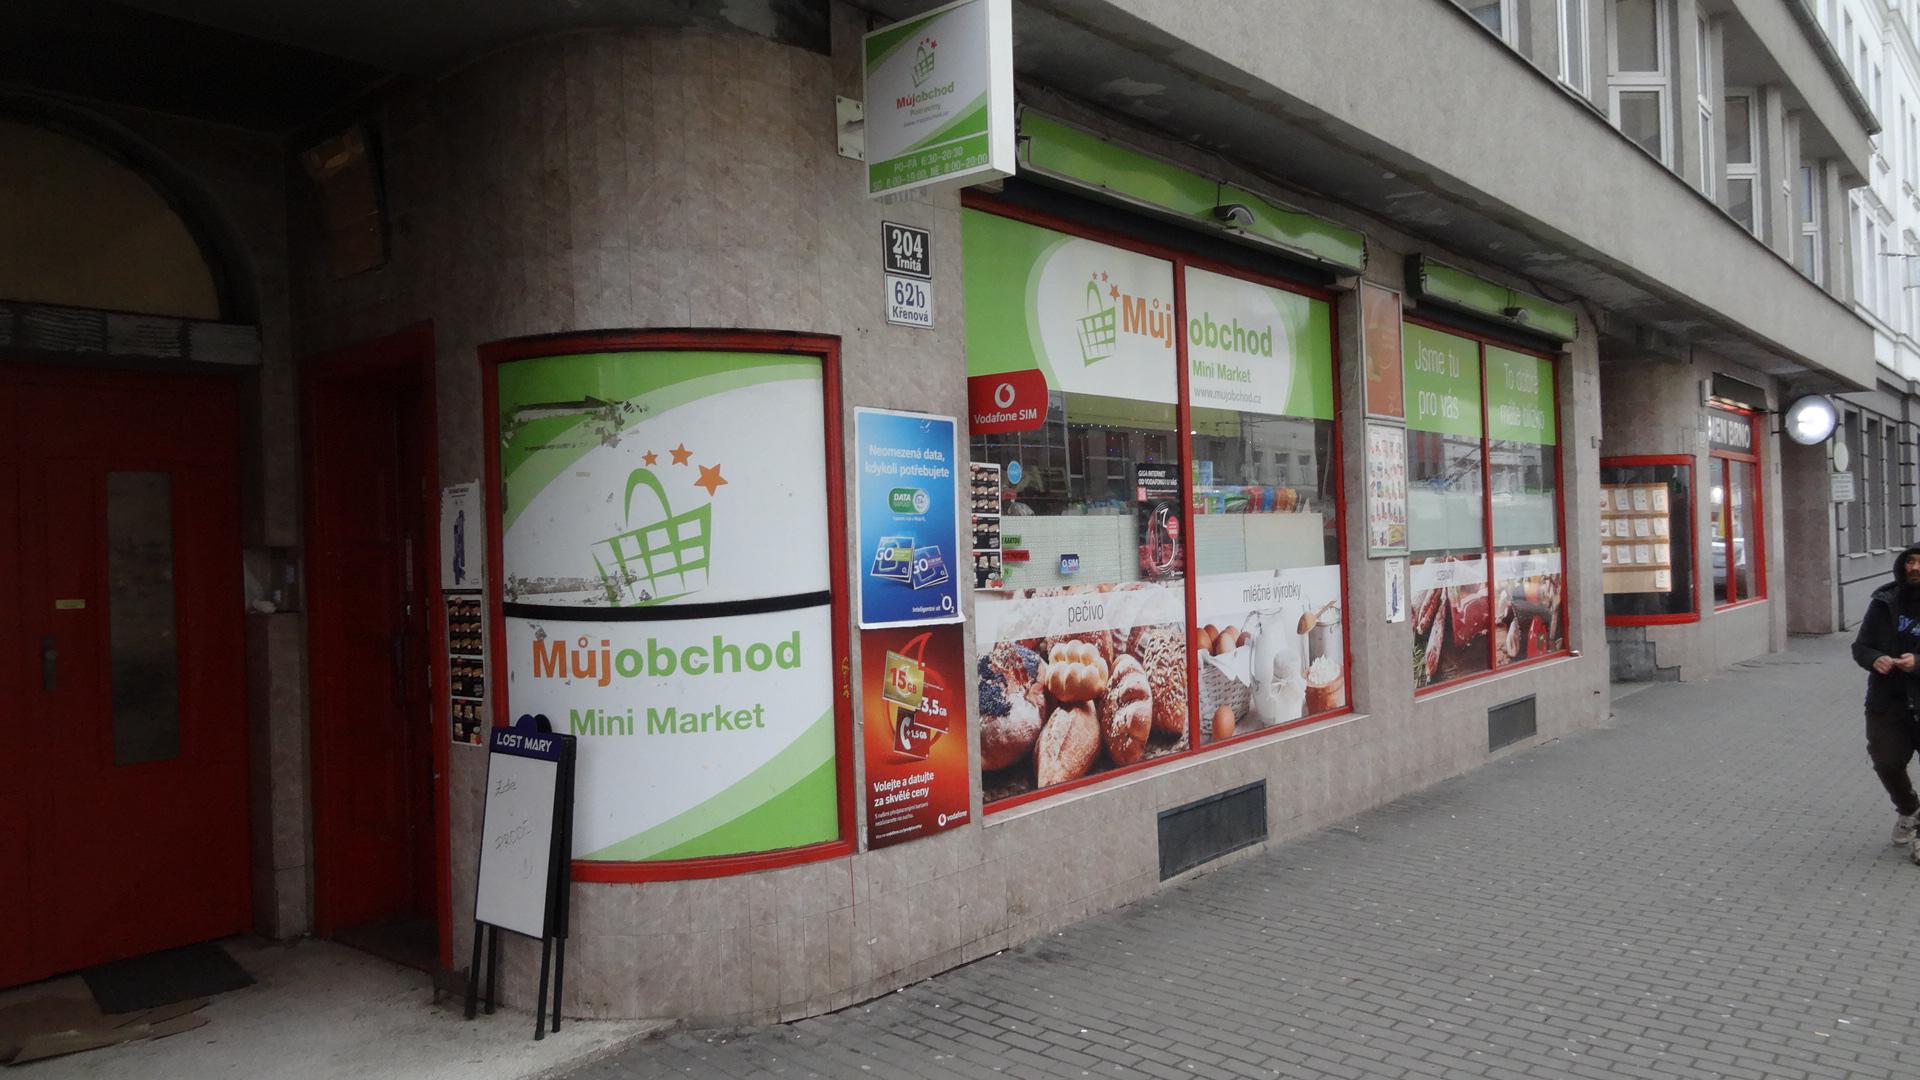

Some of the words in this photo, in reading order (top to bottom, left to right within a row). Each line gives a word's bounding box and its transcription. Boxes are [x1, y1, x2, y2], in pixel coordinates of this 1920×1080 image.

[896, 81, 955, 110] Můjobchod
[892, 229, 923, 258] 204
[895, 255, 922, 272] Trnitá
[895, 281, 925, 308] 62b
[892, 305, 929, 322] Křenová
[1122, 294, 1173, 348] Můj
[1189, 312, 1273, 357] obchod
[1414, 339, 1445, 375] Jsme
[1449, 353, 1460, 378] tu
[1192, 360, 1214, 380] Mini
[1217, 363, 1252, 384] Market
[1419, 390, 1438, 420] pro
[1441, 388, 1460, 420] vás
[974, 408, 1018, 424] Vodafone
[1019, 407, 1038, 421] SIM
[1728, 420, 1750, 449] BRNO
[869, 444, 921, 459] Neomezená
[923, 448, 945, 462] data,
[865, 461, 898, 476] kdykoli
[900, 464, 950, 480] potřebujete
[894, 493, 911, 502] DATA
[876, 547, 895, 561] GO
[913, 558, 929, 574] GO
[1243, 583, 1271, 603] mléčné
[1273, 581, 1302, 602] výrobky
[1068, 599, 1104, 628] pečivo
[532, 630, 801, 687] Můjobchod
[890, 667, 907, 690] 15
[921, 697, 939, 716] 3,5
[570, 708, 634, 736] Mini
[647, 703, 765, 735] Market
[497, 732, 523, 748] LOST
[524, 737, 552, 752] MARY
[873, 779, 901, 793] Volejte
[908, 771, 935, 785] datujte
[874, 798, 884, 807] za
[885, 788, 910, 804] skvělé
[911, 787, 929, 798] ceny
[947, 810, 968, 822] vodafone
